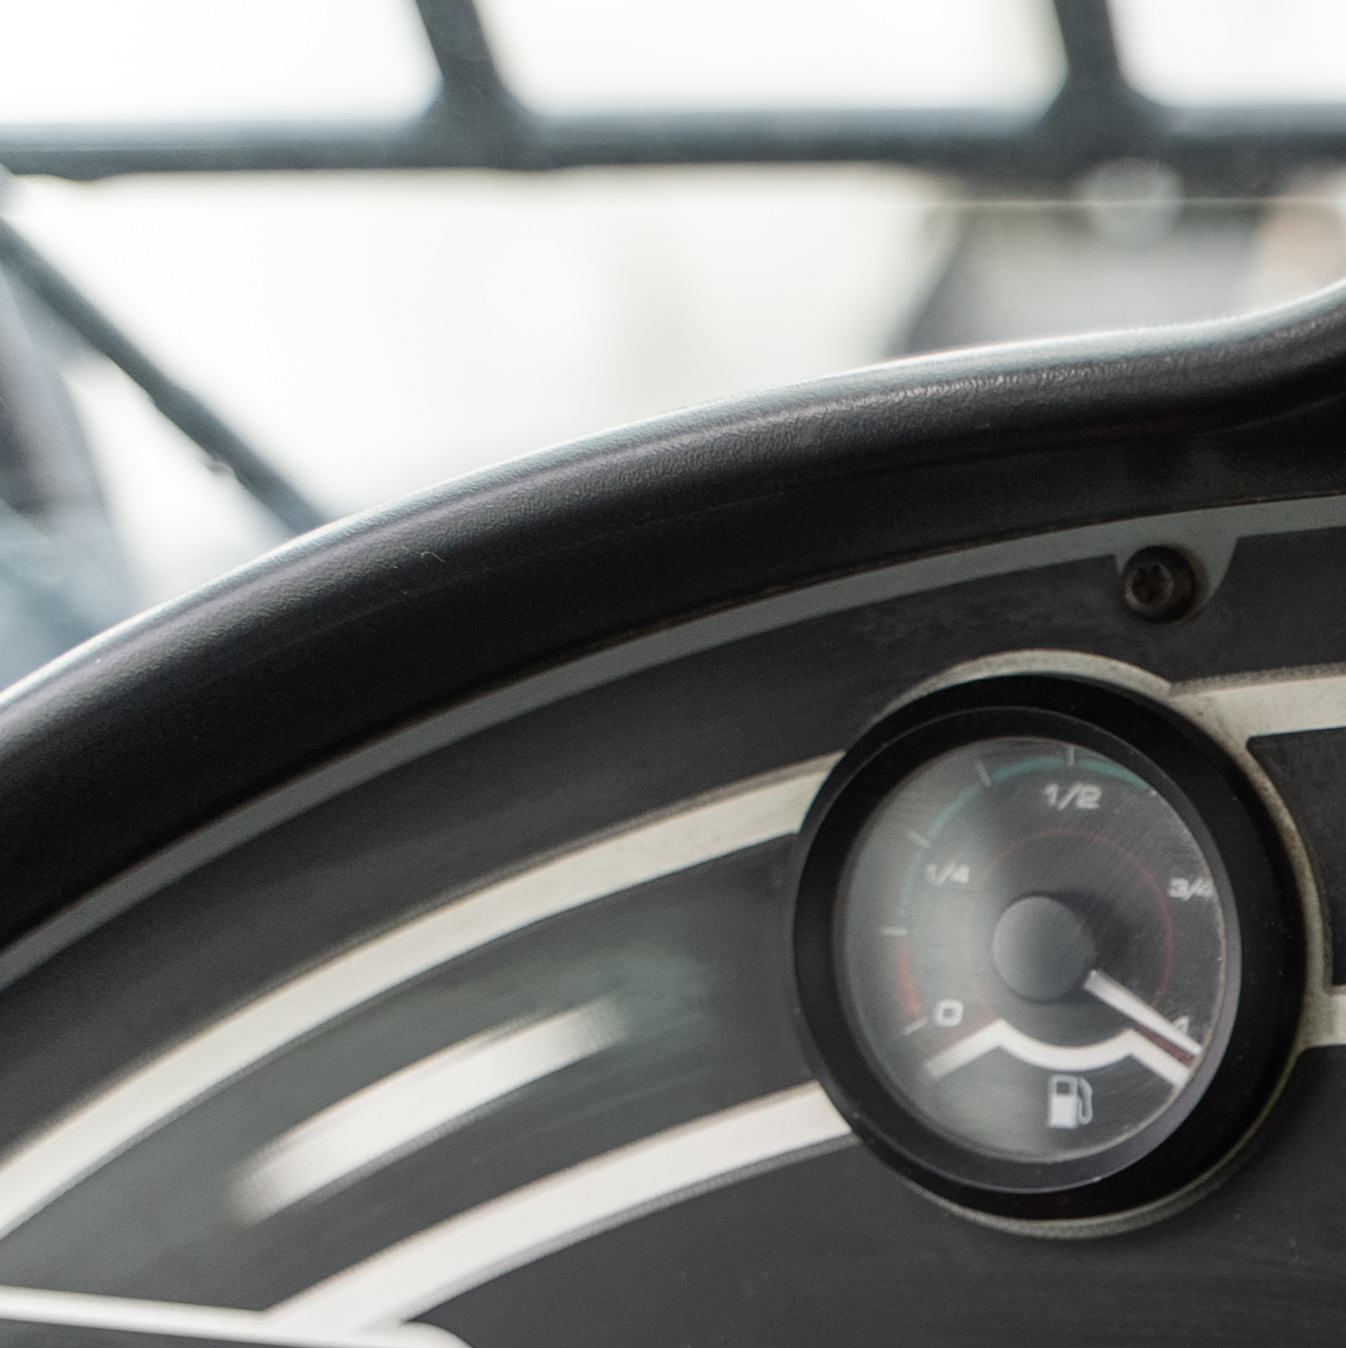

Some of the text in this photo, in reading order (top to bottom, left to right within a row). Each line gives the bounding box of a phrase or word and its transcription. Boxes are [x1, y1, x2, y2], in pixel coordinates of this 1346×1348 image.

[1043, 782, 1102, 811] 1/2
[926, 863, 970, 886] 1/4
[934, 999, 964, 1027] 0
